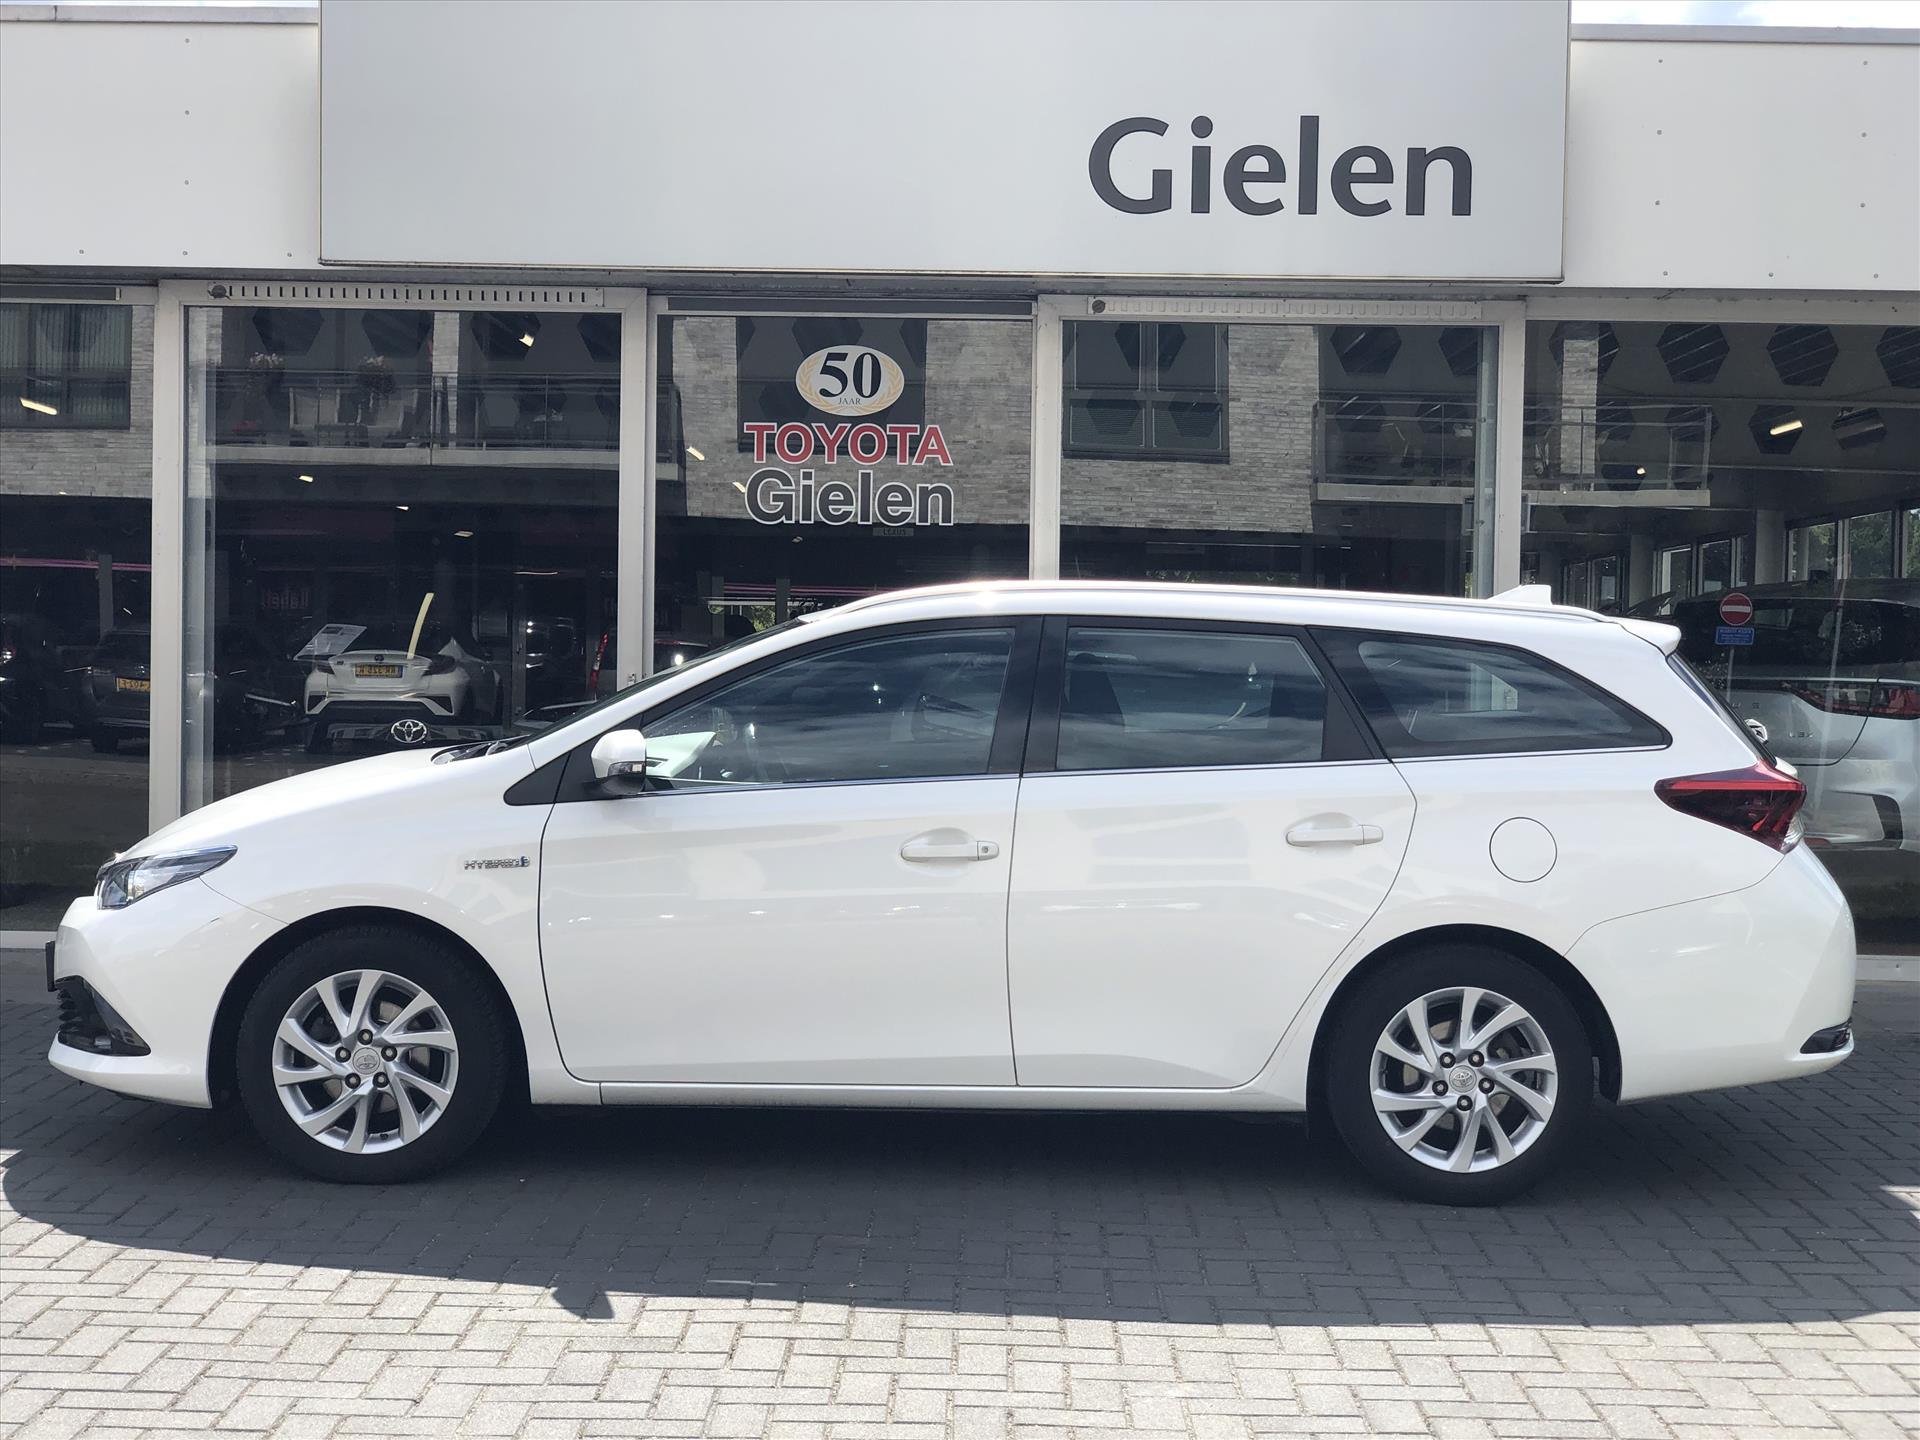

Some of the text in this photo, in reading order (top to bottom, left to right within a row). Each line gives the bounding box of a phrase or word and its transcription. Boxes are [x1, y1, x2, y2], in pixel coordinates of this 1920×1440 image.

[1088, 115, 1473, 217] Gielen
[819, 352, 882, 398] 50
[838, 397, 861, 405] JAAR
[744, 422, 953, 465] TOYOTA
[745, 467, 954, 526] Gielen
